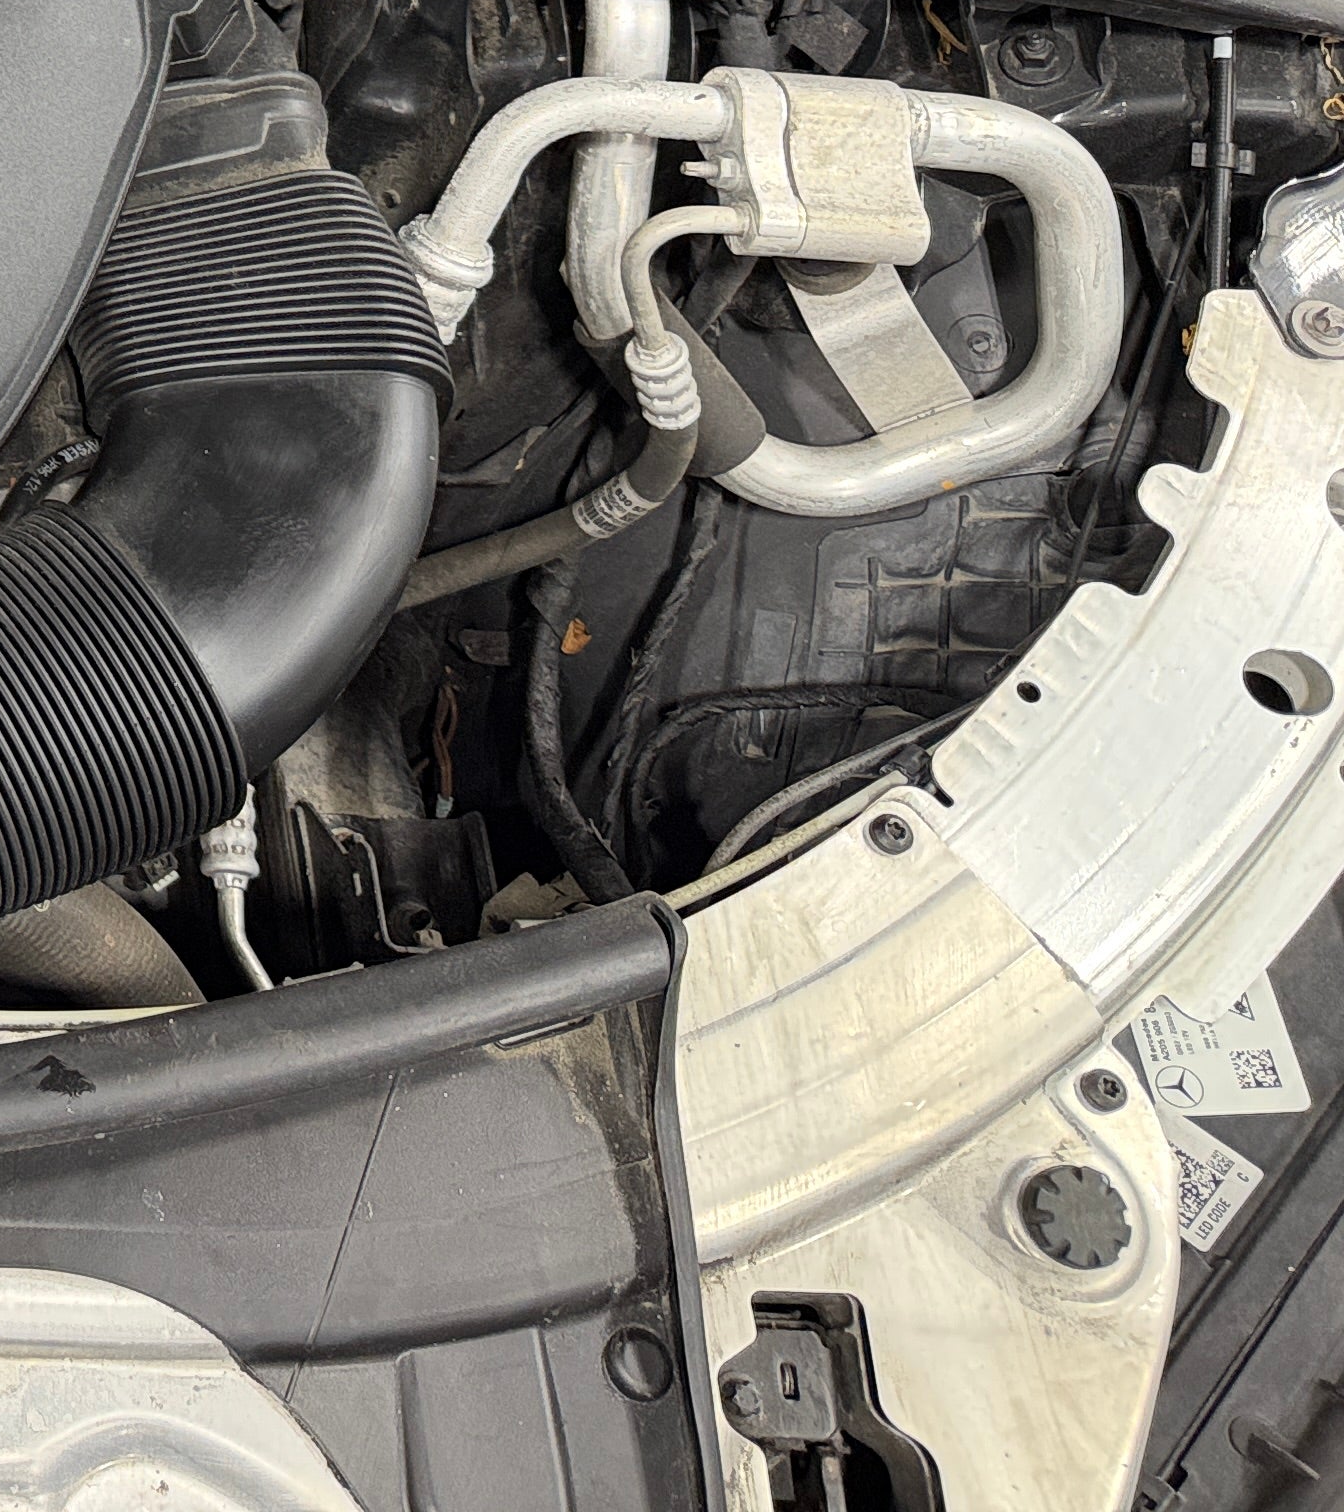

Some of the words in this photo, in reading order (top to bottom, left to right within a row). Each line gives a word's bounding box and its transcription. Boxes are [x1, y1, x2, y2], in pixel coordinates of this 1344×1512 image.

[1141, 1018, 1160, 1061] Mercedes
[1194, 1220, 1213, 1240] LED
[1207, 1197, 1231, 1223] CODE
[1236, 1171, 1249, 1183] C
